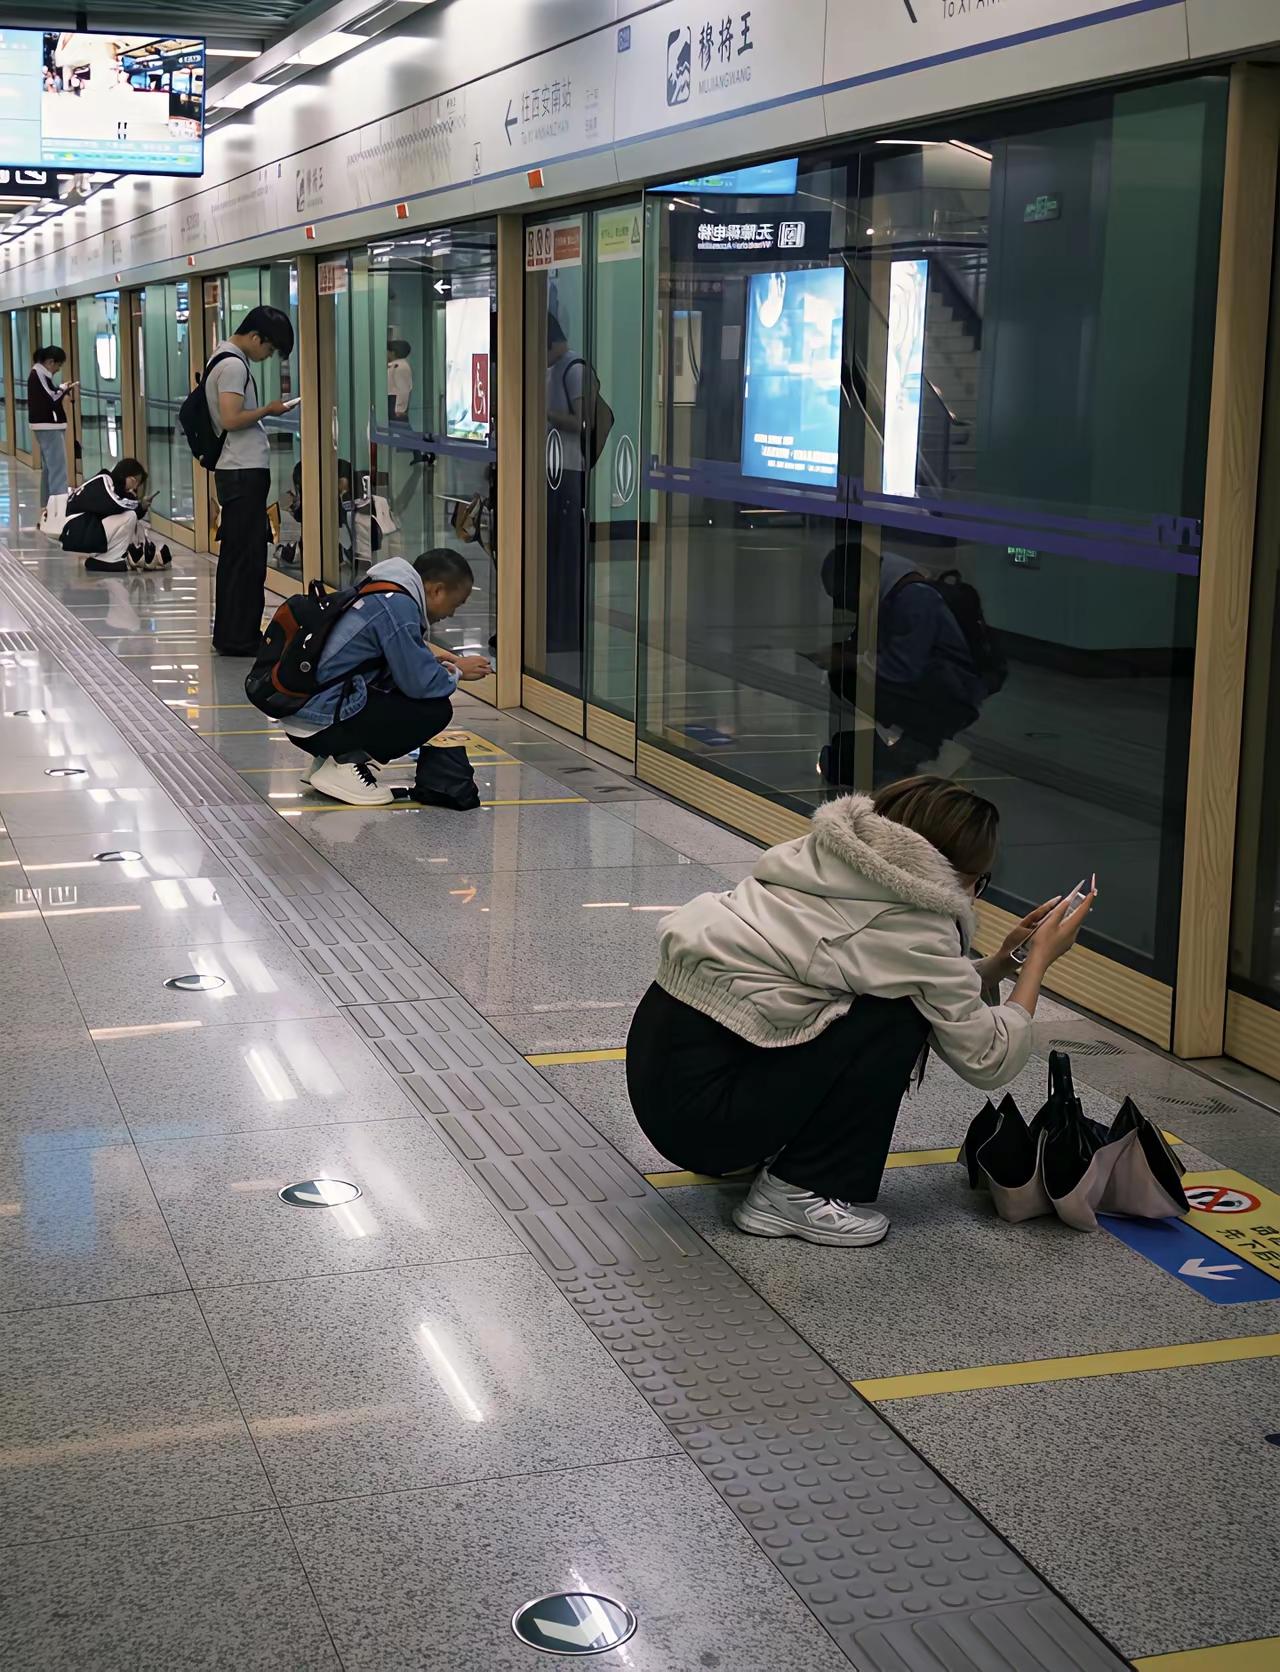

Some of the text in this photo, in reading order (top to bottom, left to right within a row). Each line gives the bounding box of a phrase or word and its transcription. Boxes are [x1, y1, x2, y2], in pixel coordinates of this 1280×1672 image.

[698, 11, 753, 72] 穆将王
[1216, 1228, 1280, 1269] 先下后
